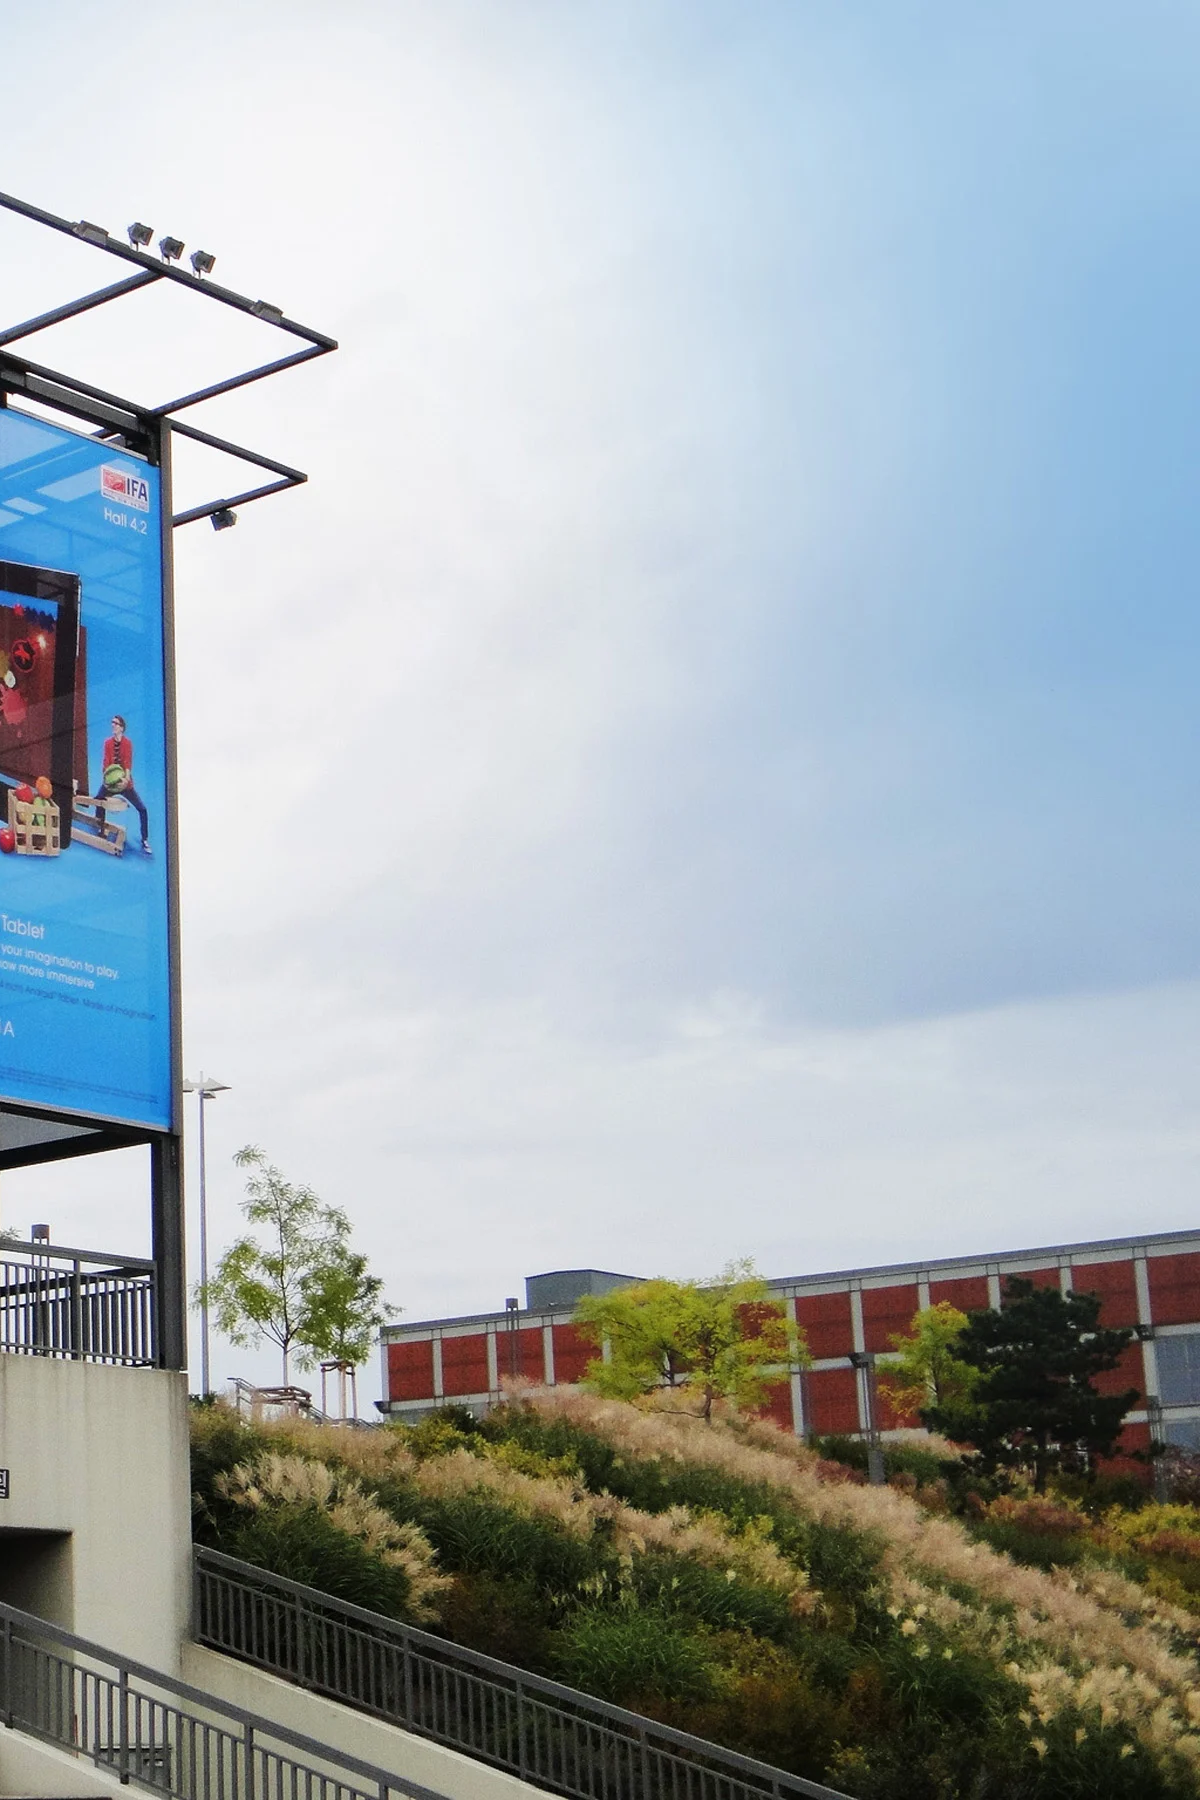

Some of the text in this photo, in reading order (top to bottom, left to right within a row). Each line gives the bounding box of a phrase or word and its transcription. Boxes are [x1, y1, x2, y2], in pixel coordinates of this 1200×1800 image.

[127, 478, 148, 502] IFA
[104, 507, 148, 535] Hall 4.2
[1, 914, 45, 940] Tablet
[1, 943, 23, 956] your
[25, 947, 83, 970] imagination
[84, 962, 95, 974] to
[18, 964, 45, 978] more
